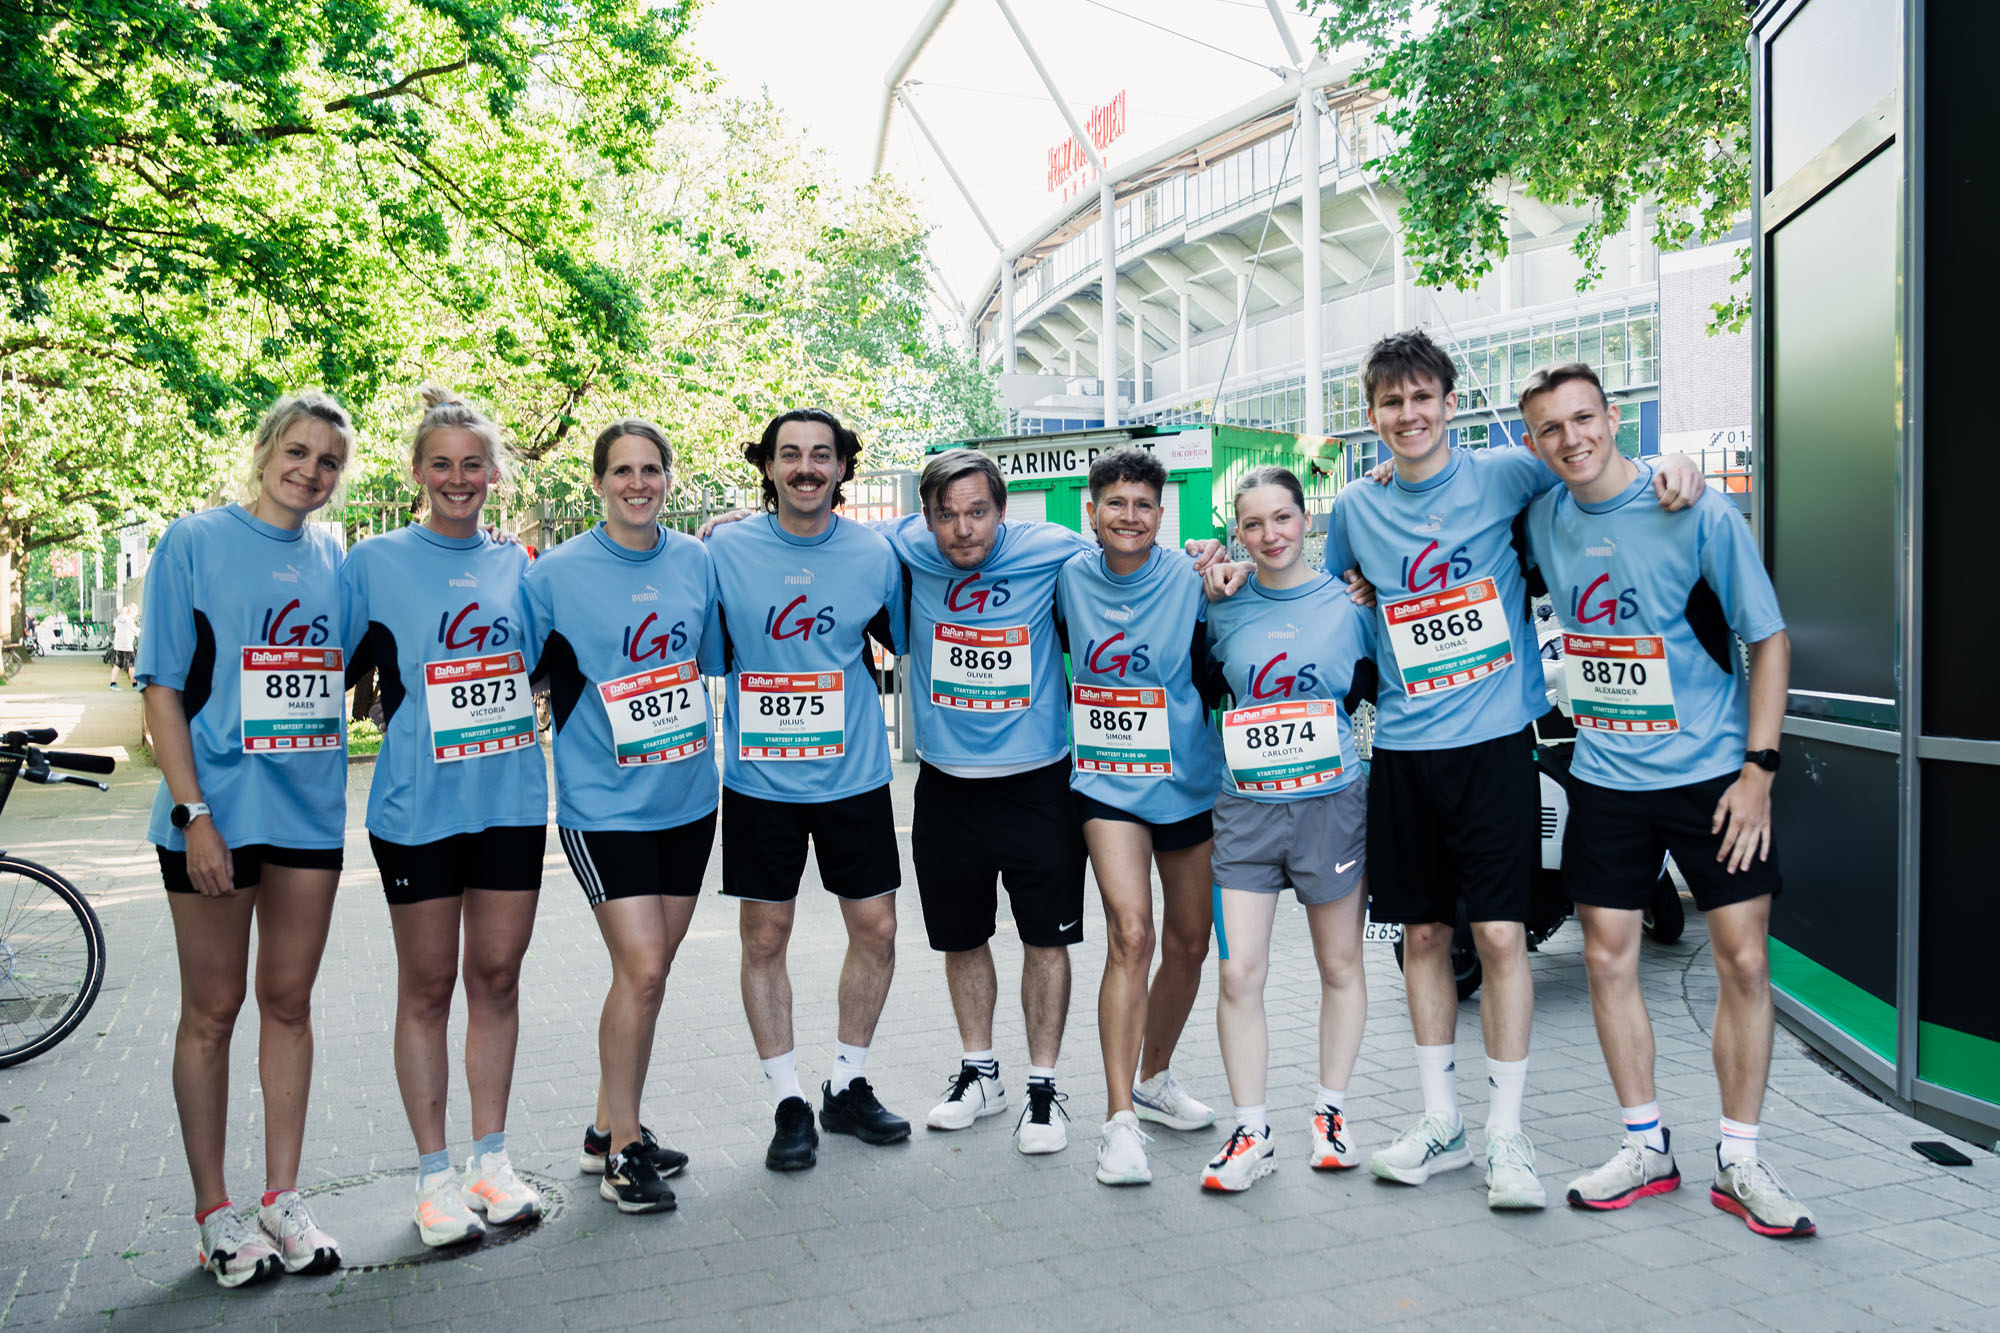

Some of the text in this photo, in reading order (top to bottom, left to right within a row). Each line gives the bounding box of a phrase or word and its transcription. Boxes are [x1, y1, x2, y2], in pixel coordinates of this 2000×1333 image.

[1401, 540, 1472, 593] IGS
[943, 572, 1011, 614] IGS
[1571, 573, 1638, 626] IGS
[261, 598, 329, 646] IGS
[438, 602, 509, 652] IGS
[764, 594, 836, 641] IGS
[1411, 609, 1483, 646] 8868
[623, 611, 688, 663] IGS
[1435, 638, 1468, 652] LEONAS
[949, 646, 1012, 670] 8869
[1083, 632, 1150, 678] IGS
[266, 674, 330, 698] 8871
[966, 671, 993, 679] OLIVER
[1247, 652, 1318, 700] IGS
[1581, 660, 1647, 686] 8870
[451, 679, 517, 709] 8873
[629, 687, 691, 721] 8872
[759, 695, 825, 716] 8875
[1594, 686, 1638, 696] ALEXANDER
[470, 706, 506, 717] VICTORIA
[652, 715, 679, 727] SVENJA
[1089, 709, 1148, 732] 8867
[1105, 733, 1133, 741] SIMONE
[1245, 721, 1316, 750] 8874
[1262, 746, 1304, 758] CARLOTTA
